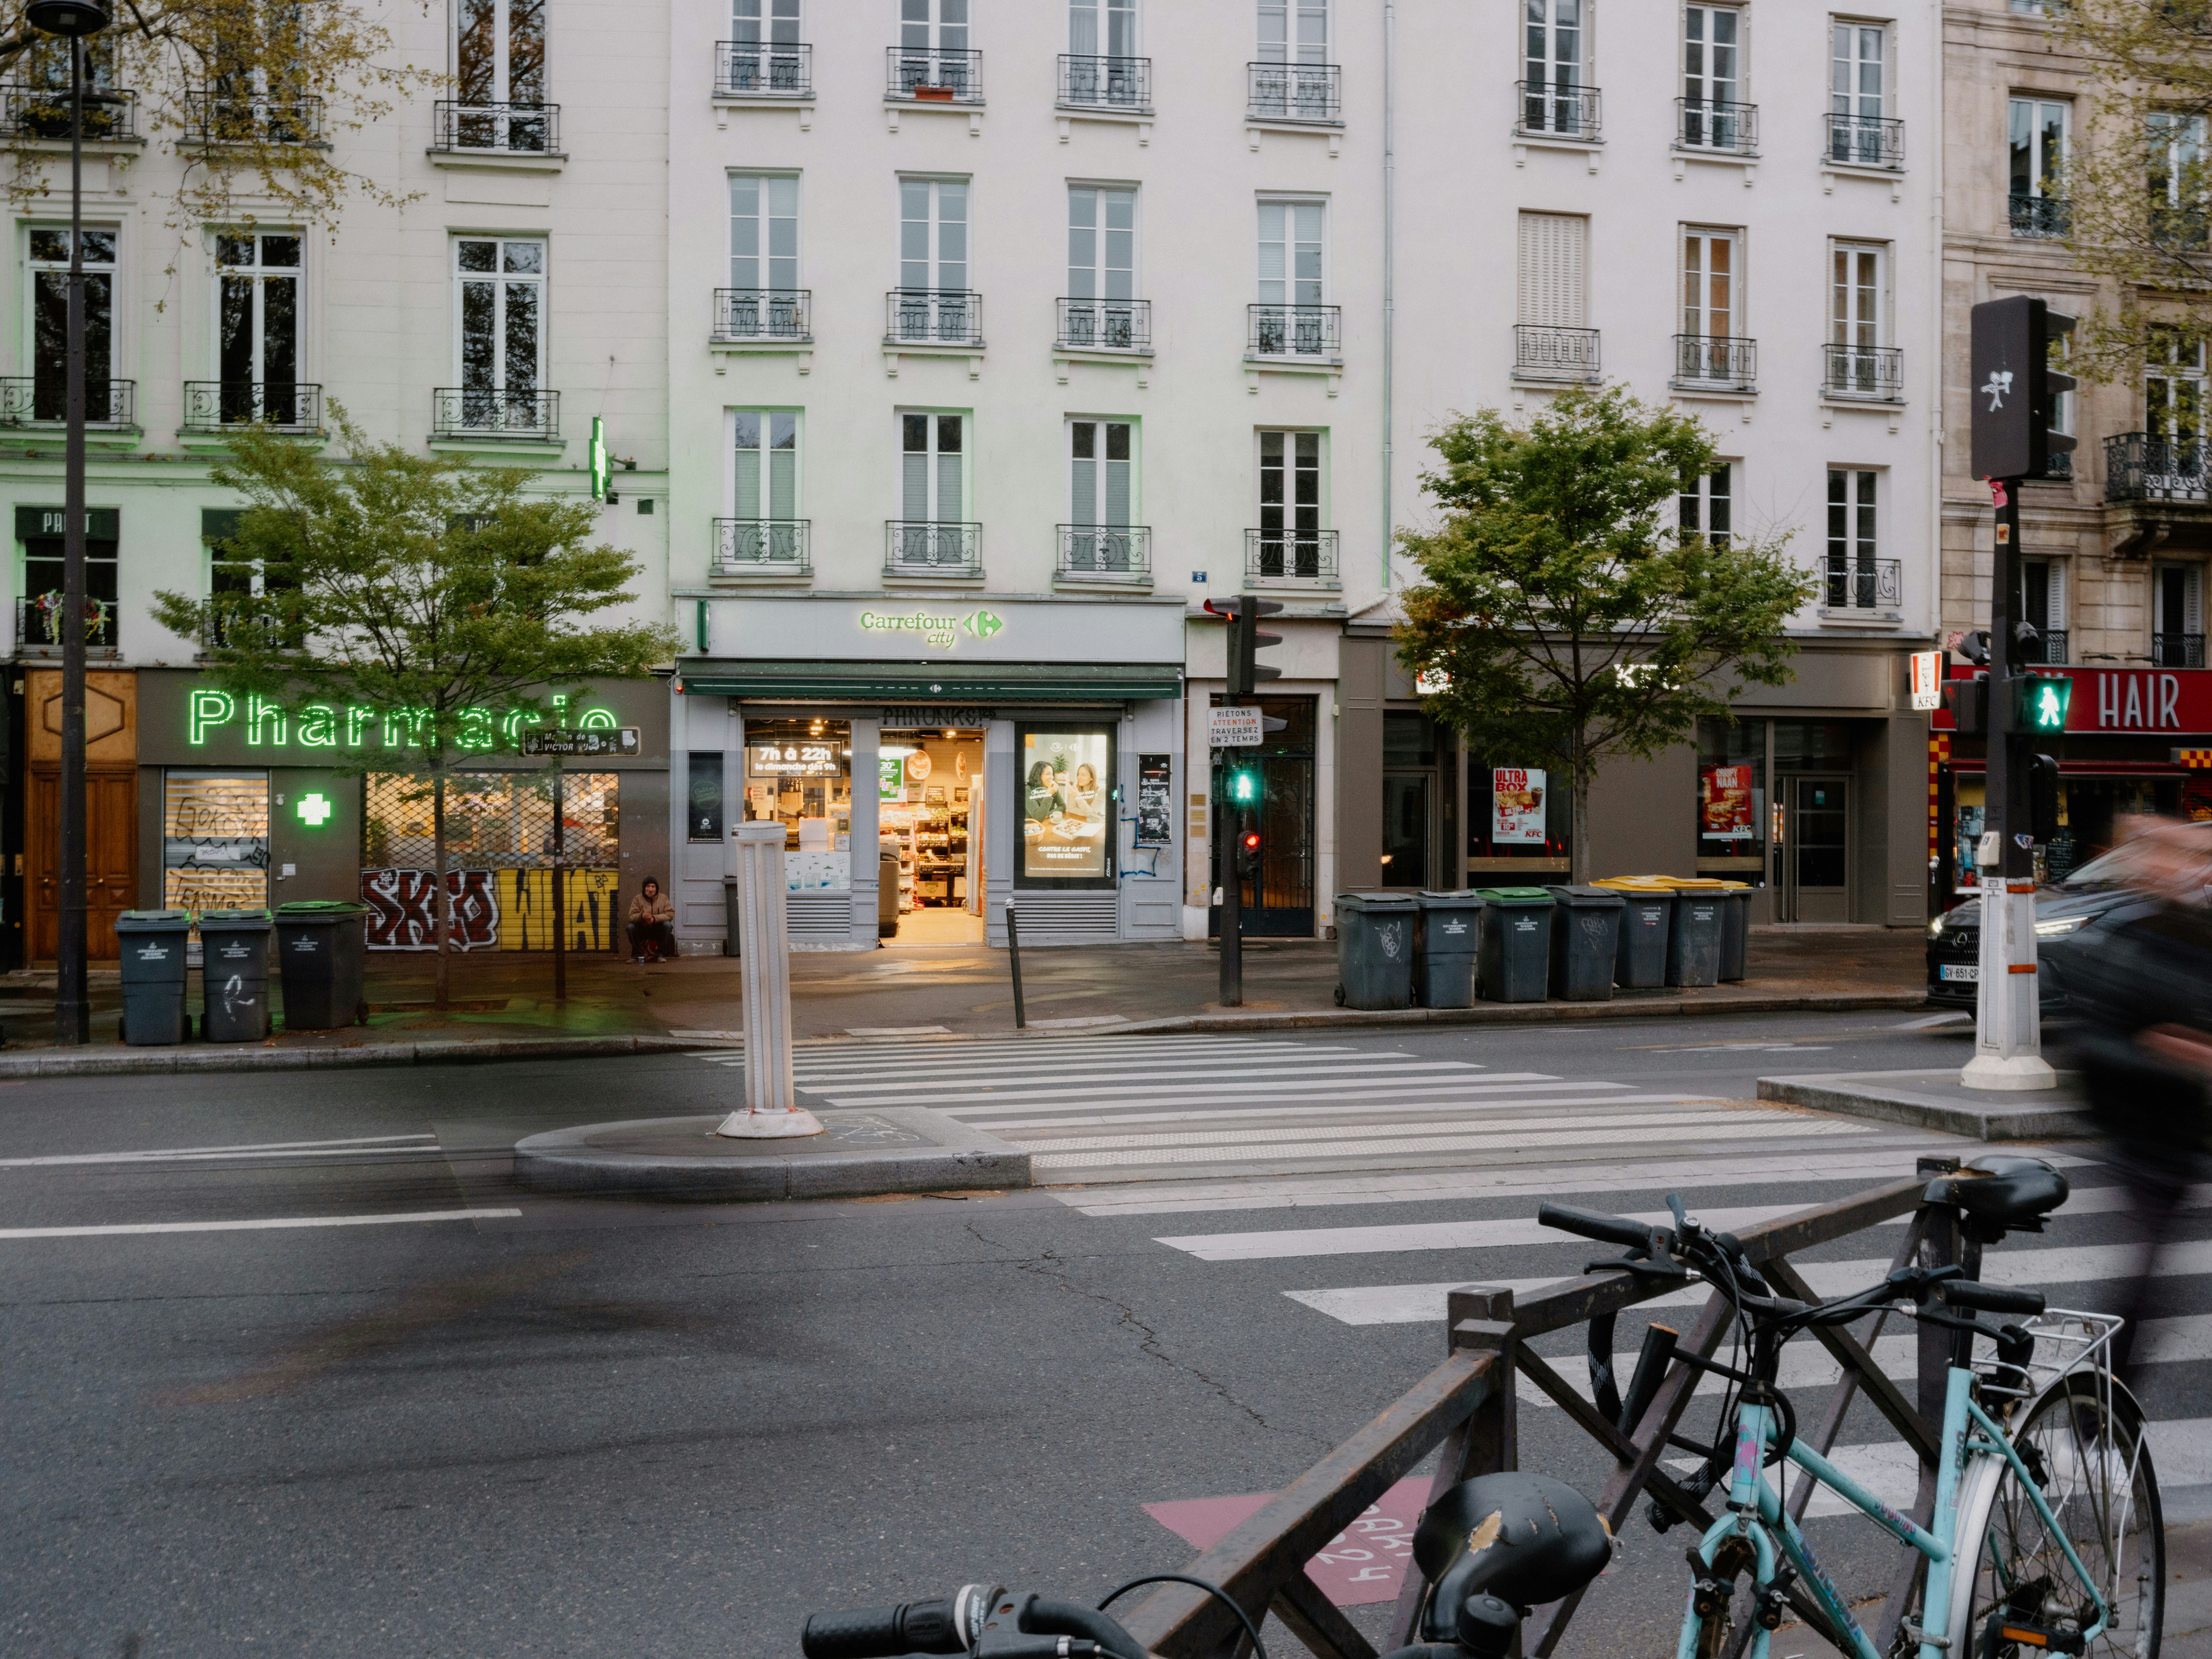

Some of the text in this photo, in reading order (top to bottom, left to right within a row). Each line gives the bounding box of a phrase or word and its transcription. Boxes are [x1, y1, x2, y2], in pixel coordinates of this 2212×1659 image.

[861, 612, 956, 629] Carrefour
[928, 631, 955, 648] city
[1917, 695, 1937, 707] KFC
[2098, 673, 2180, 728] HAIR
[545, 743, 574, 751] VICTOR
[760, 747, 831, 760] 7h à 22h
[1496, 770, 1528, 783] ULTRA
[1717, 777, 1738, 788] NAAN
[1496, 783, 1527, 792] BOX
[1954, 1430, 1965, 1471] PRO
